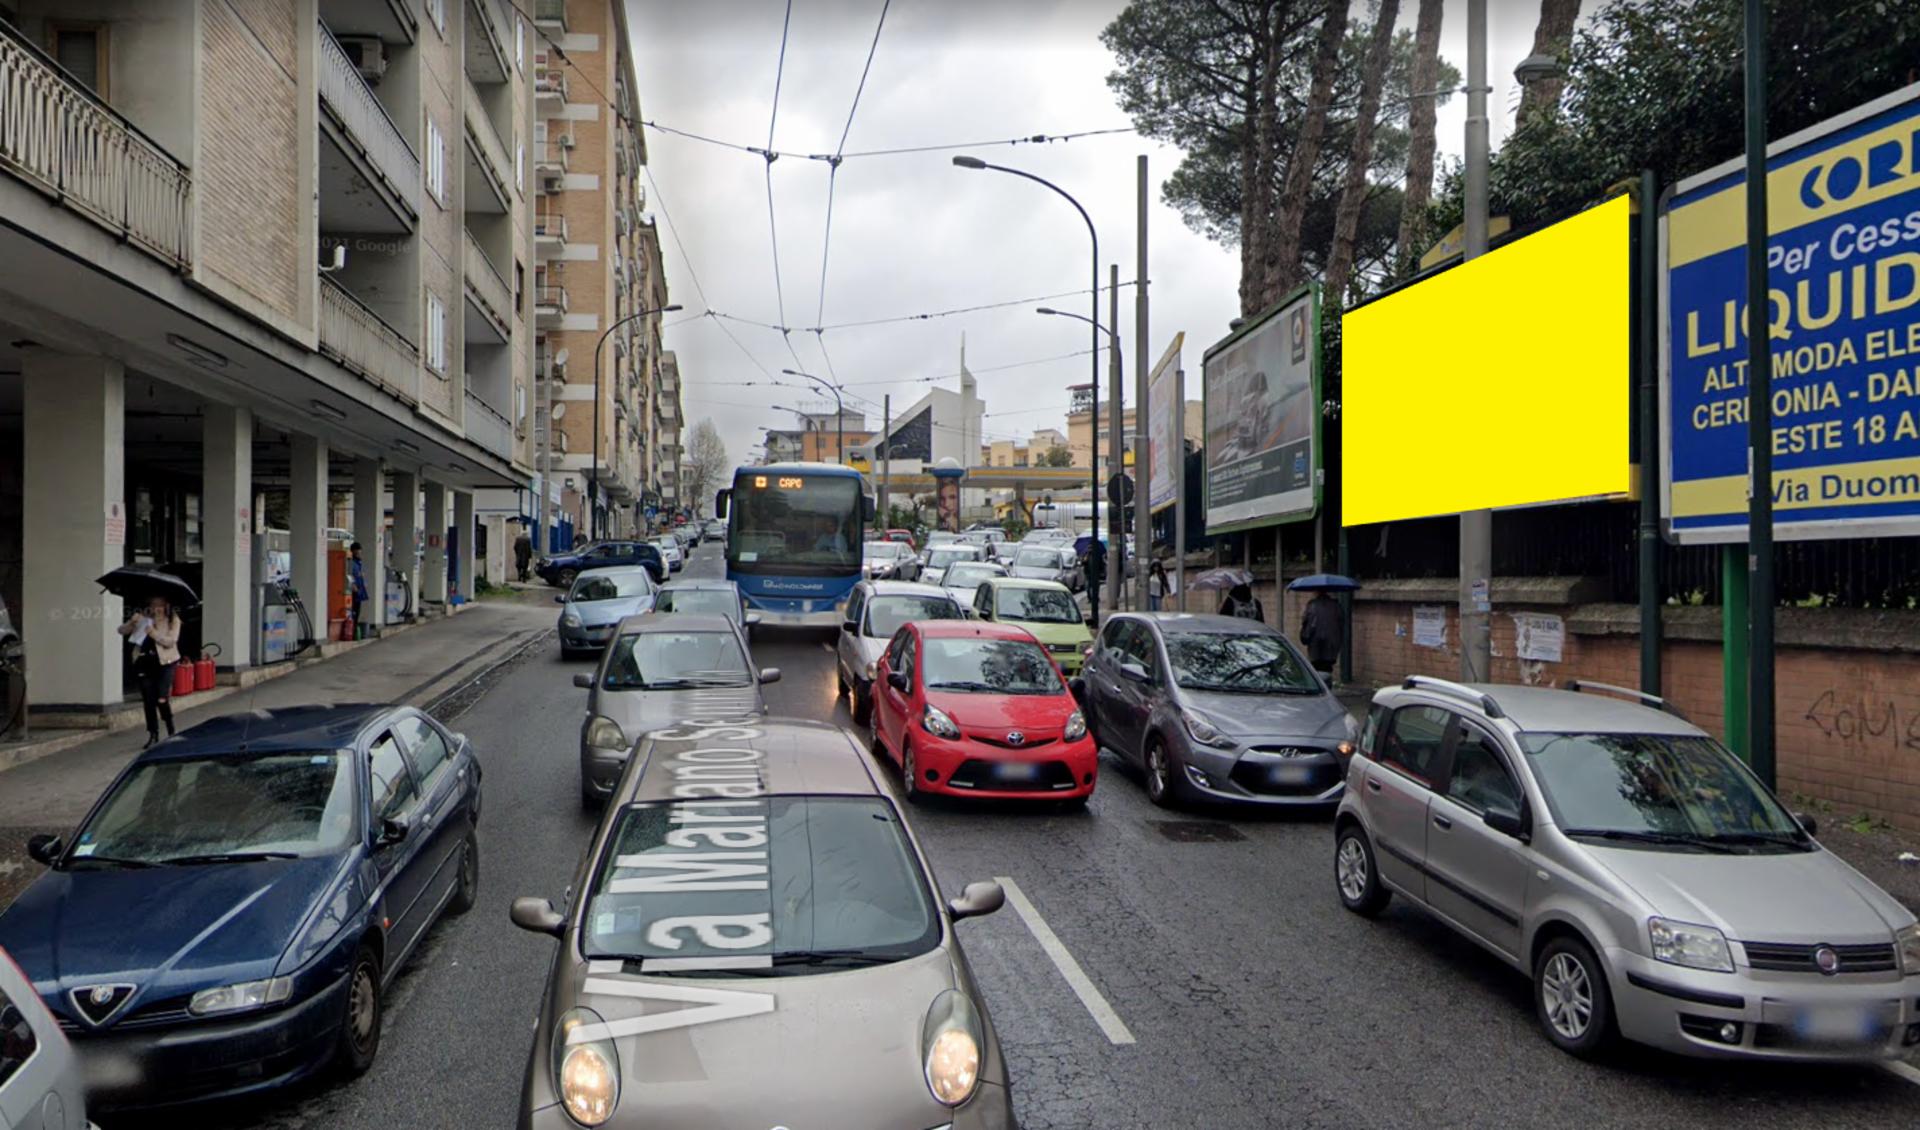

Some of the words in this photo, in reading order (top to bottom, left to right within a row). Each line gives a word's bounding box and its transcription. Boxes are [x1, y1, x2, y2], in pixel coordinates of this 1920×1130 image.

[1830, 211, 1920, 261] Cess
[1687, 252, 1920, 358] LIQUID
[1703, 360, 1749, 393] ALT
[1772, 338, 1858, 379] MODA
[1866, 322, 1920, 361] ELE
[1693, 381, 1841, 430] CERIONIA
[1868, 366, 1920, 402] DA
[1771, 420, 1842, 455] ESTE
[1853, 415, 1886, 445] 18
[1821, 473, 1920, 501] Duom
